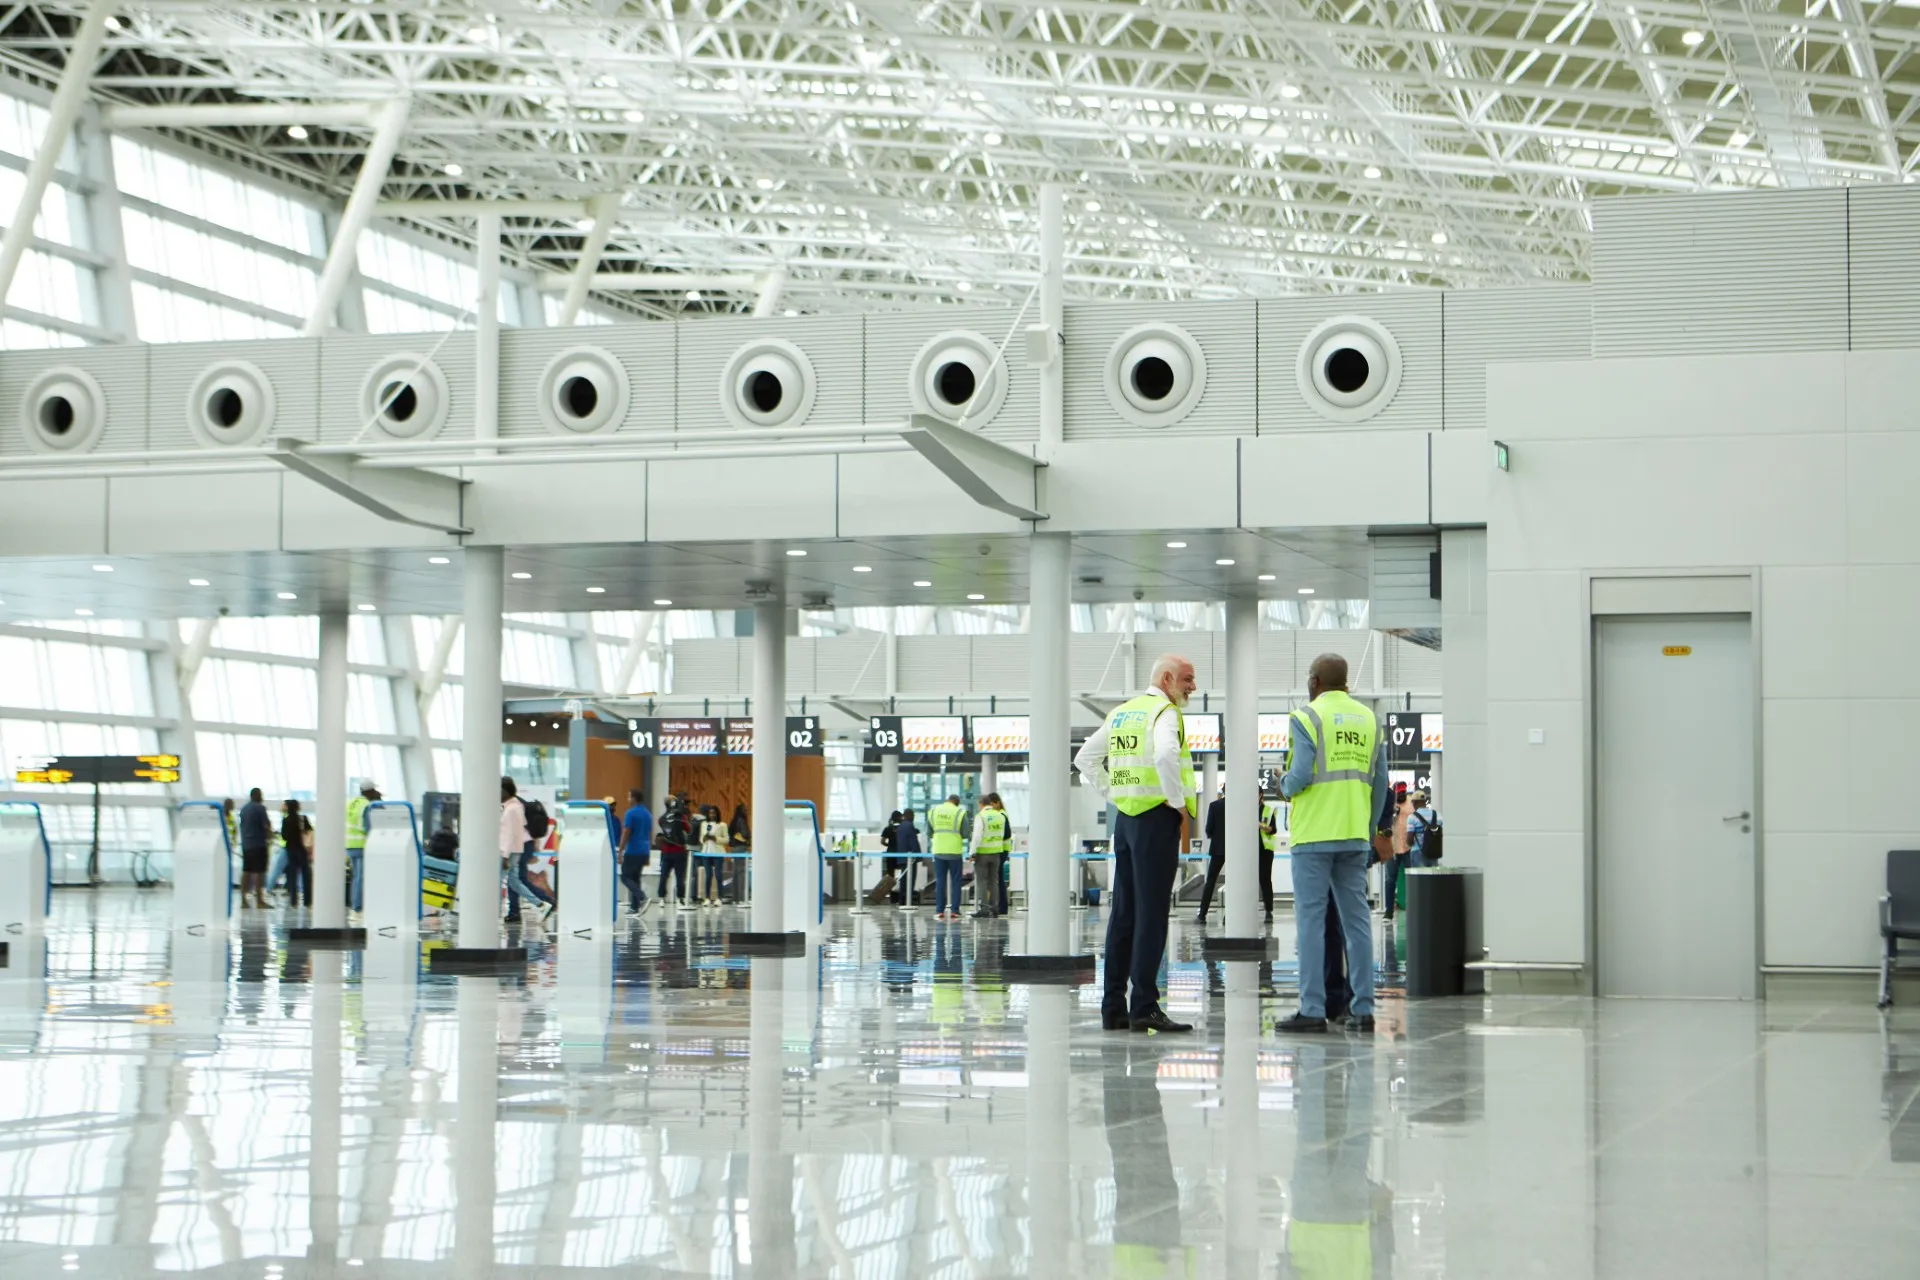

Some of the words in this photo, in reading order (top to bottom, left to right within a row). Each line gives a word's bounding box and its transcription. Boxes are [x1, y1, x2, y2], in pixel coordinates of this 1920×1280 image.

[628, 719, 638, 731] B
[804, 718, 814, 729] B
[871, 718, 881, 729] B
[1389, 714, 1398, 727] B
[632, 731, 653, 748] 01
[789, 731, 813, 748] 02
[875, 730, 898, 747] 03
[1335, 730, 1367, 747] FNBJ
[1392, 727, 1416, 746] 07
[1263, 769, 1270, 778] C
